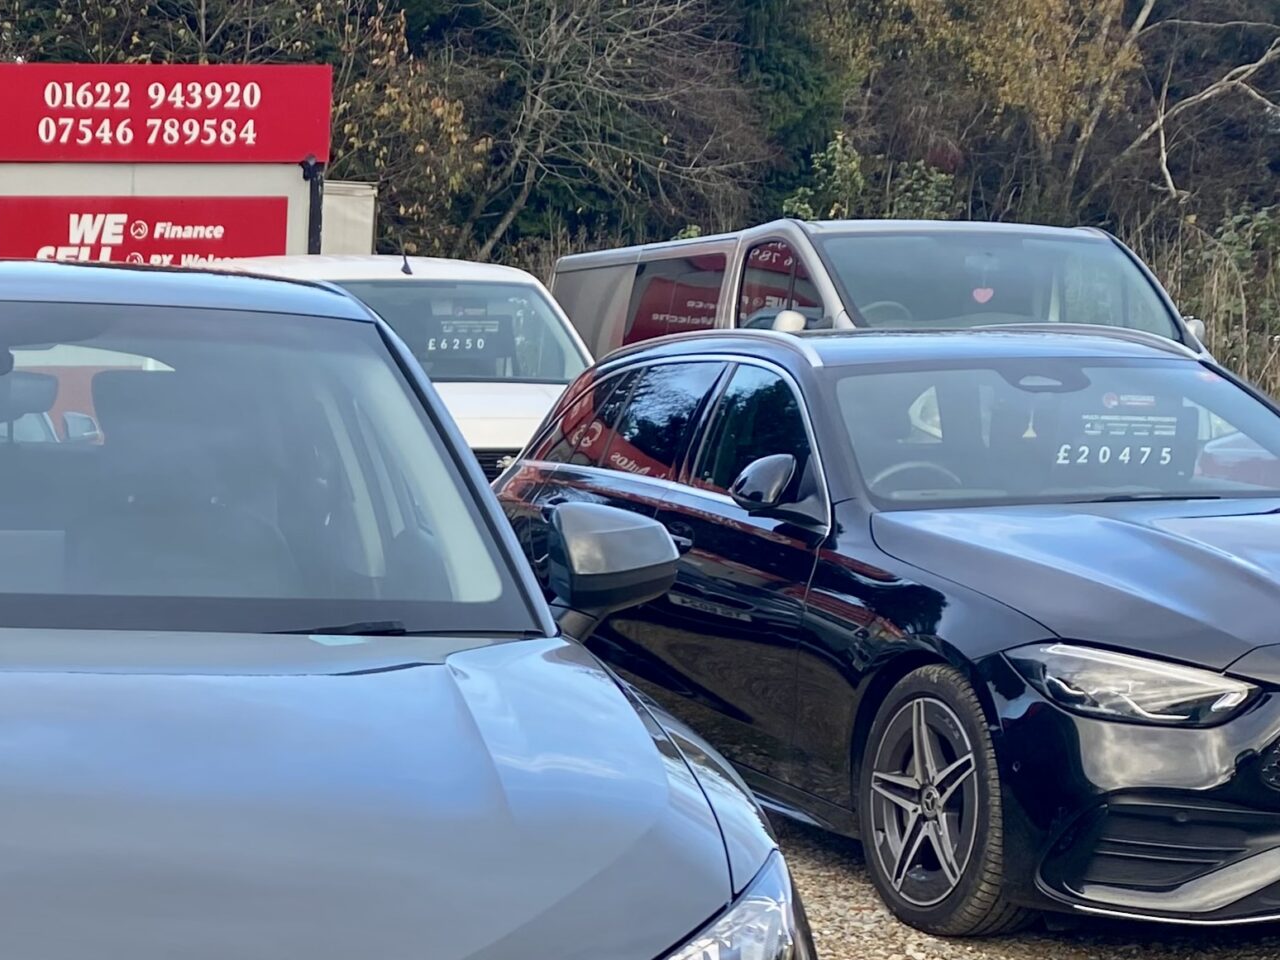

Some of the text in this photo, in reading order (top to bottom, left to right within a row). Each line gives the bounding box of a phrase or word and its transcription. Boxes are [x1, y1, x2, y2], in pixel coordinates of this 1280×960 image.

[44, 82, 261, 109] 01622 943920
[38, 117, 256, 145] 07546 789584
[69, 213, 128, 244] WE
[153, 222, 225, 239] Finance
[428, 338, 485, 350] £6250
[1056, 444, 1172, 464] £20475
